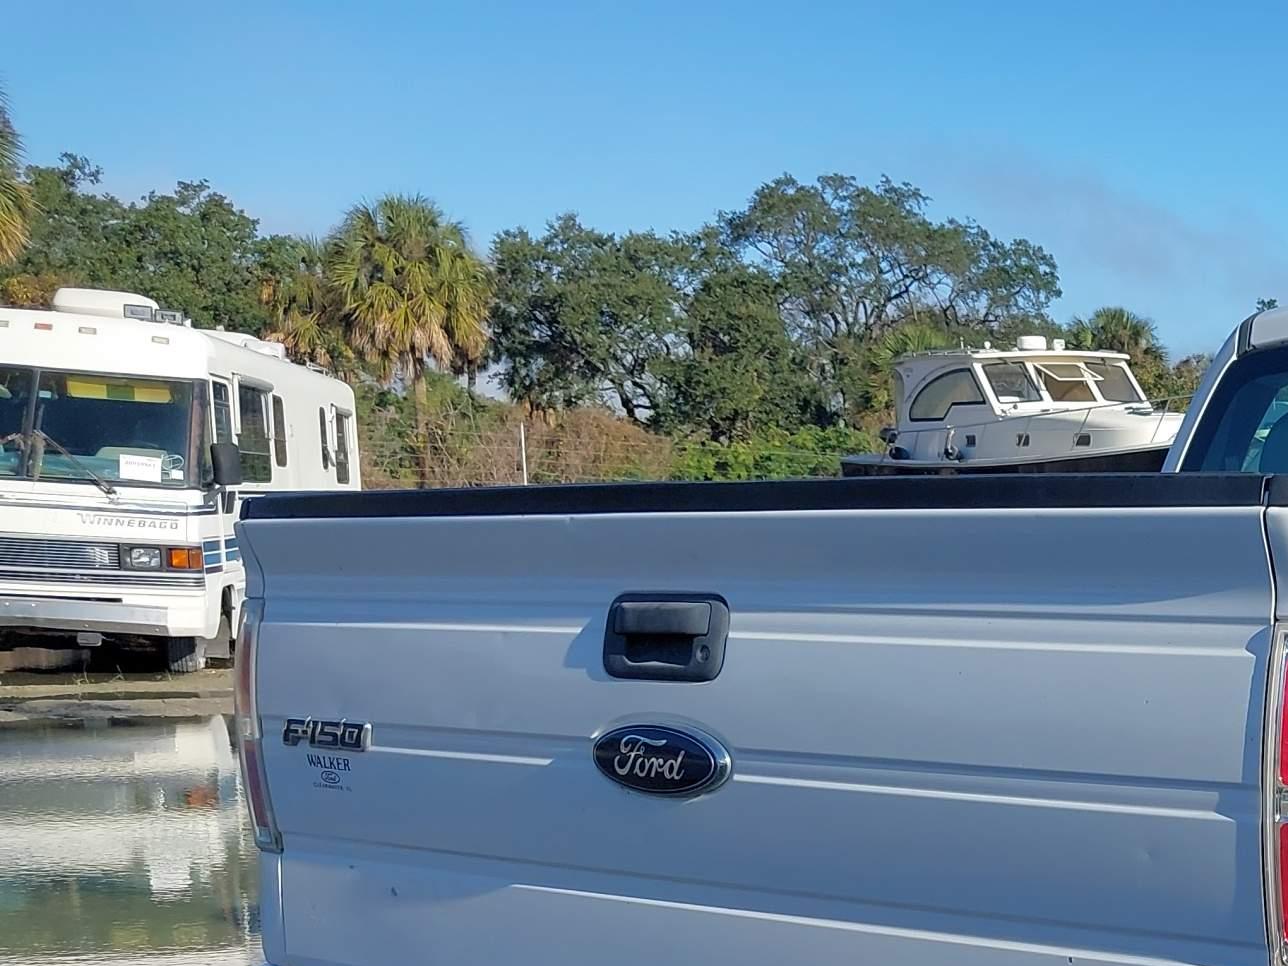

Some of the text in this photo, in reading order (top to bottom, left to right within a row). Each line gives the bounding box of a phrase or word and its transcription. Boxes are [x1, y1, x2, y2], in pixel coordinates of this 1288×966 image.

[77, 512, 179, 530] WINNEBAGO
[283, 718, 365, 752] F-150
[307, 754, 351, 771] WALKER
[614, 734, 685, 780] Ford
